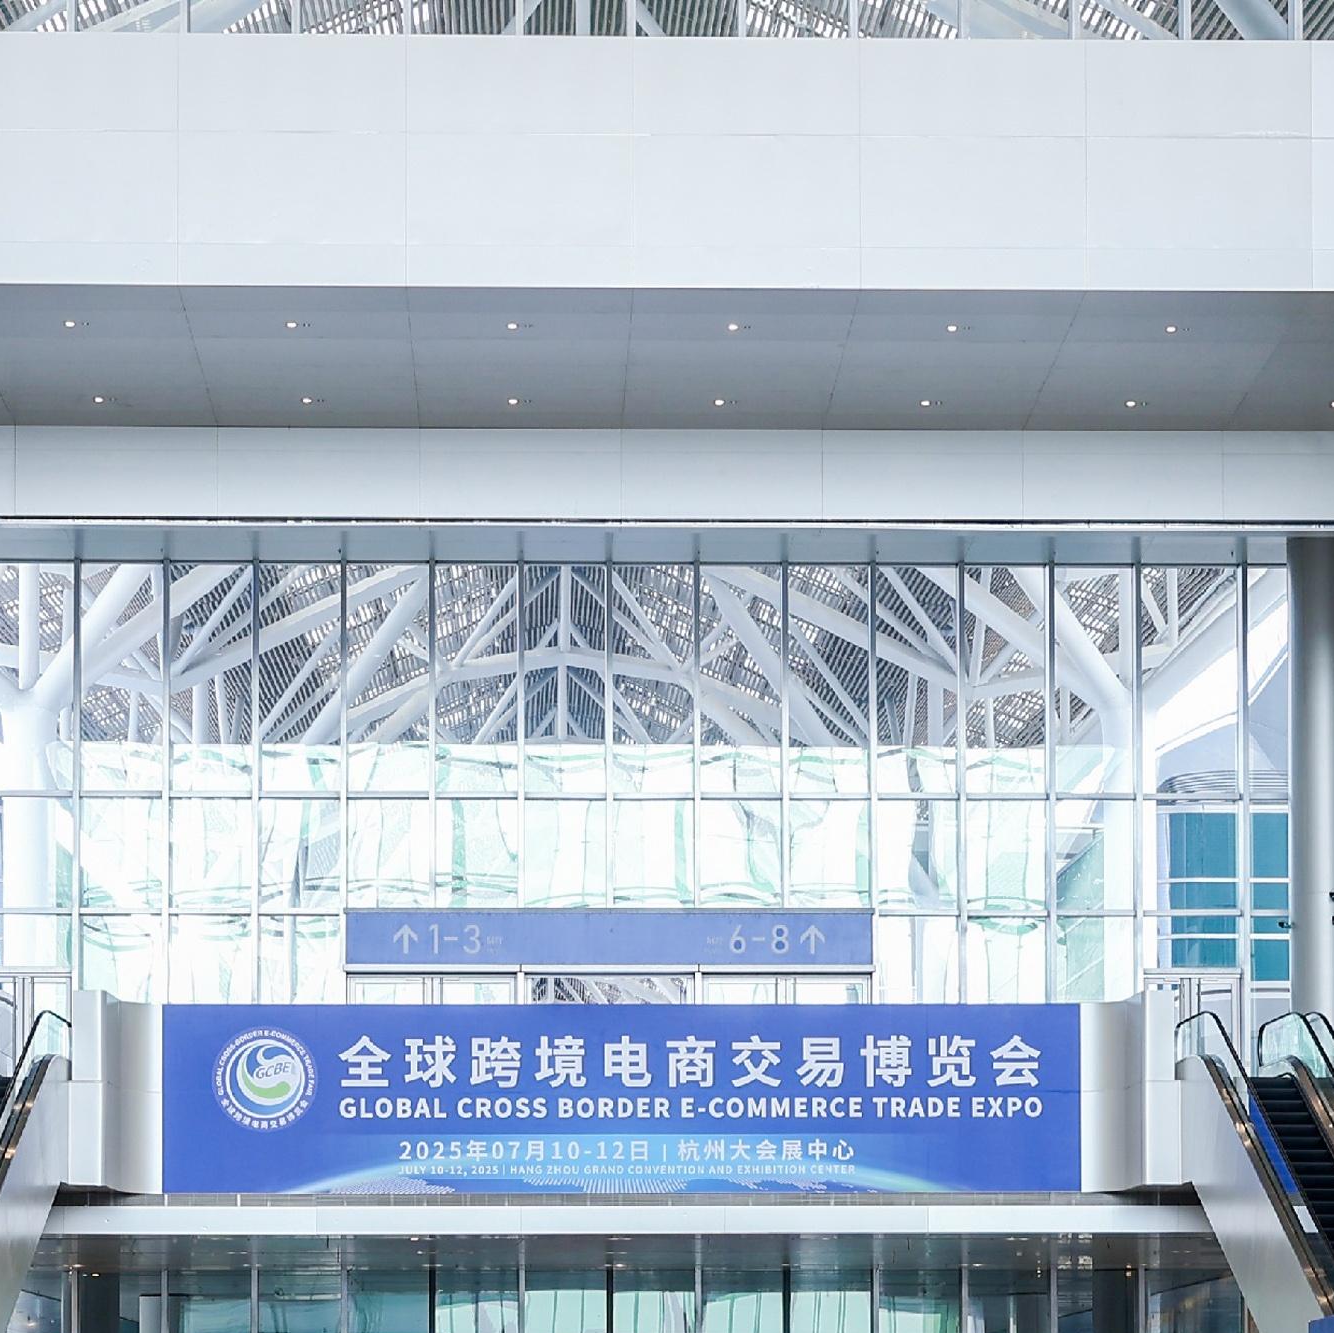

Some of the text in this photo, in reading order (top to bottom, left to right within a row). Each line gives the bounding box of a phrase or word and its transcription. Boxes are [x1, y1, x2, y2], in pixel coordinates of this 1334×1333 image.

[429, 924, 482, 955] 1-3
[730, 924, 789, 955] 6-8
[255, 1062, 292, 1079] GCBE
[339, 1035, 1040, 1087] 全球跨境电商交易博览会
[340, 1097, 1043, 1119] GLOBAL CROSS BORDER E-COMMERCE TRADE EXPO
[398, 1139, 854, 1162] 2025年07月10-12日 杭州大会展中心
[398, 1164, 855, 1176] JULY 10-12, 2025 HANG ZHOU GRAND CONVENTION AND EXHIBITION CENTER
